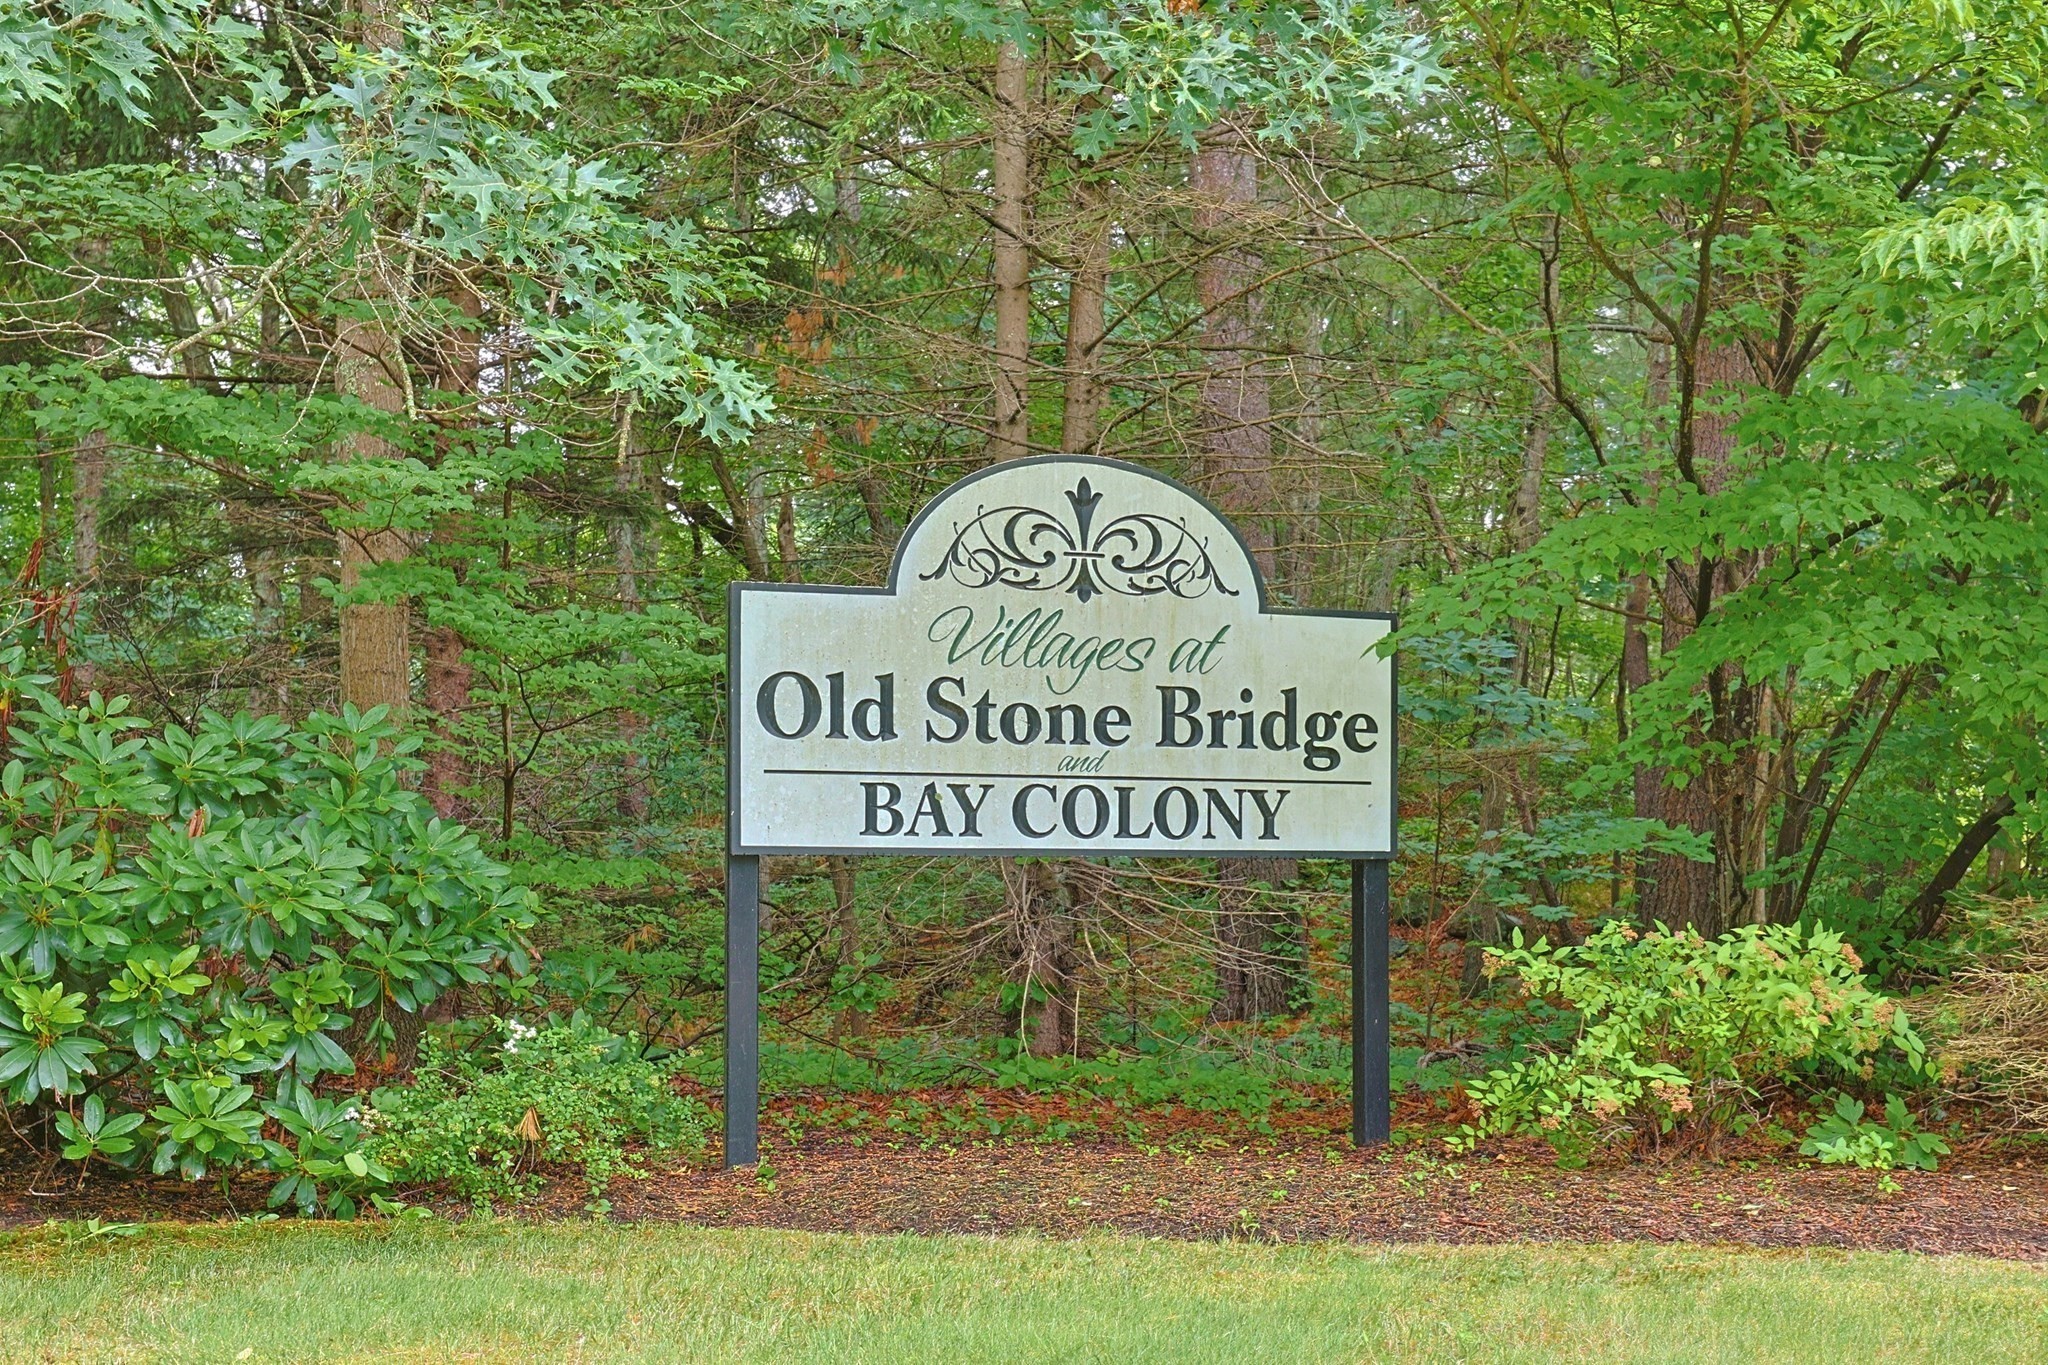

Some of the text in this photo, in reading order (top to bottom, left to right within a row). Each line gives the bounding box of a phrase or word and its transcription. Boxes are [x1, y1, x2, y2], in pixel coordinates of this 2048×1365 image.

[928, 605, 1232, 695] Villages at
[756, 671, 1379, 771] Old Stone Bridge
[1057, 750, 1110, 773] and
[859, 781, 1291, 840] BAY COLONY
